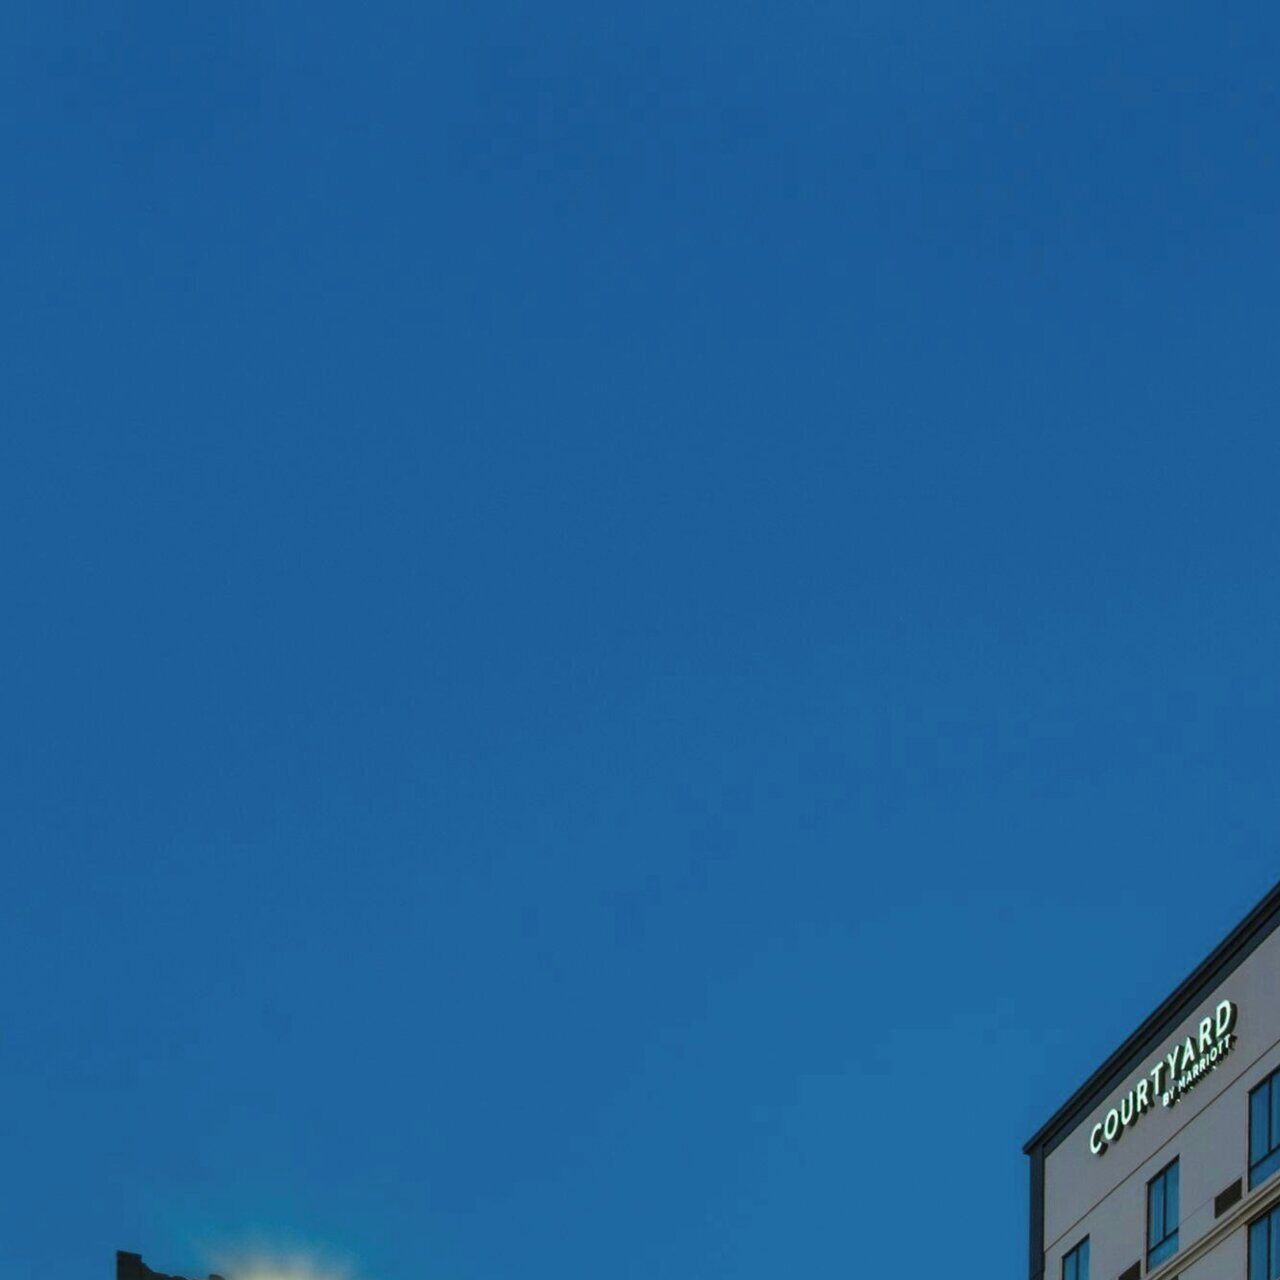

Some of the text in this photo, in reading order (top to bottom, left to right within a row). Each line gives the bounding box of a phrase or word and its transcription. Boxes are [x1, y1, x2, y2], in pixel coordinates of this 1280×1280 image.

[1089, 999, 1232, 1154] COURTYARD
[1162, 1033, 1231, 1107] BY MARRIOTT
